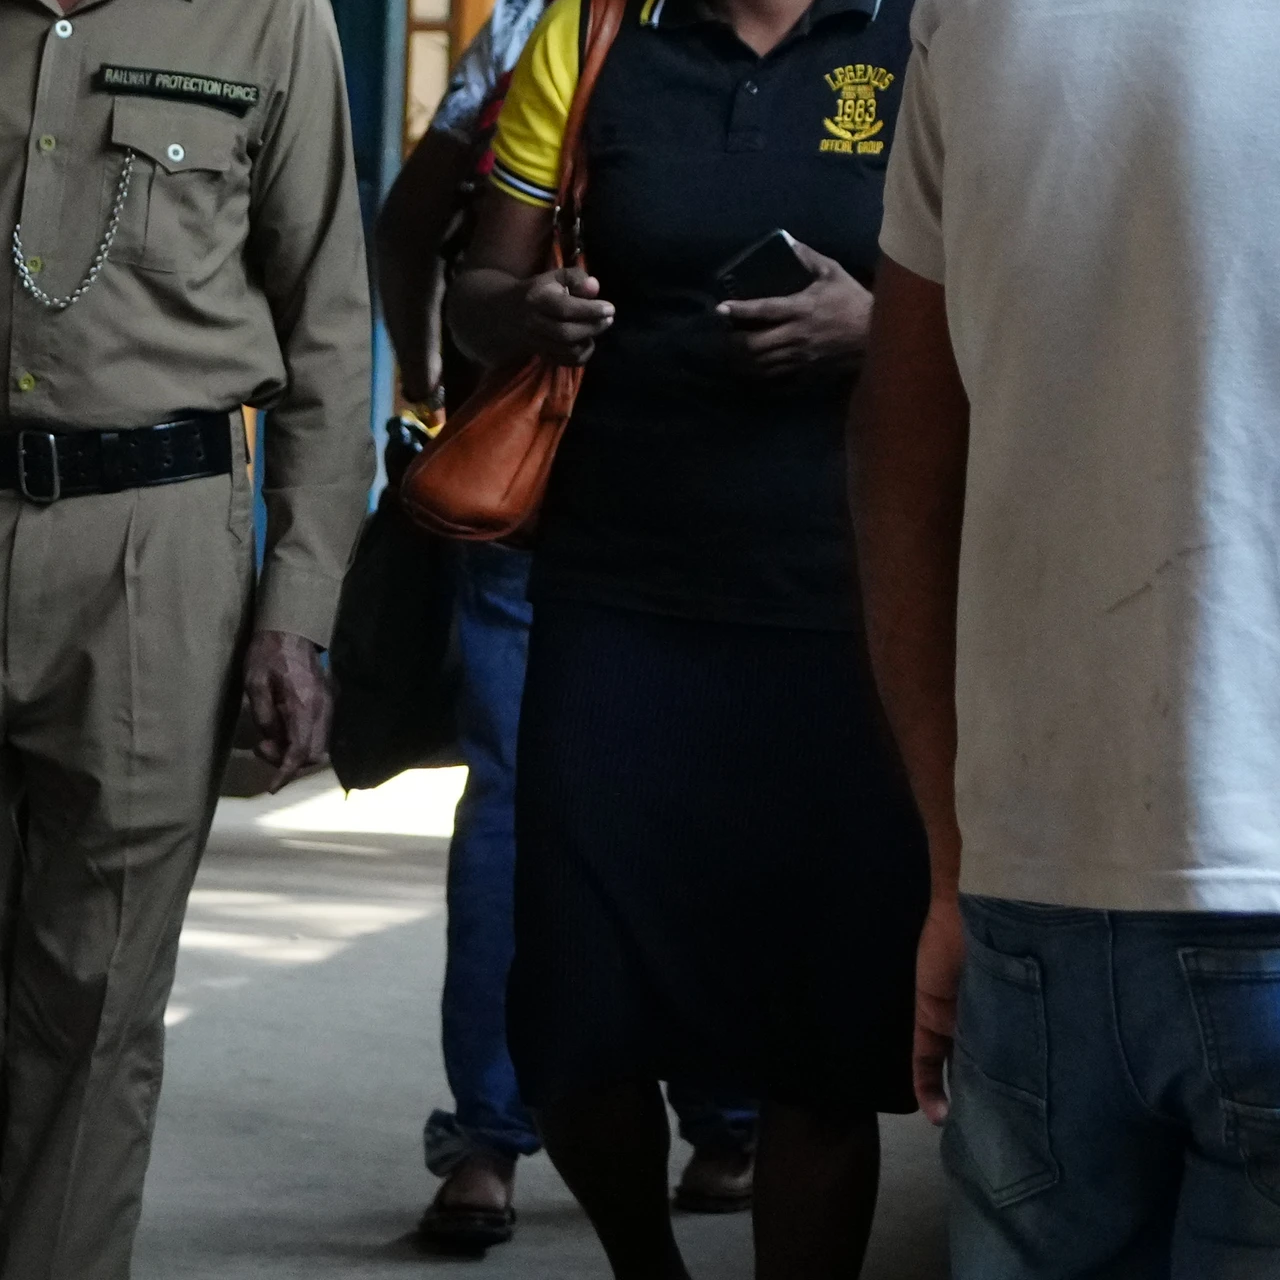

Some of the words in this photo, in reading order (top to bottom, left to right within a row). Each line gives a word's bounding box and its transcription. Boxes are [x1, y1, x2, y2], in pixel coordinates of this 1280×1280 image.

[104, 68, 152, 85] RAILWAY
[155, 73, 222, 95] PROTECTION
[222, 83, 258, 101] FORCE
[823, 63, 895, 92] LEGENDS
